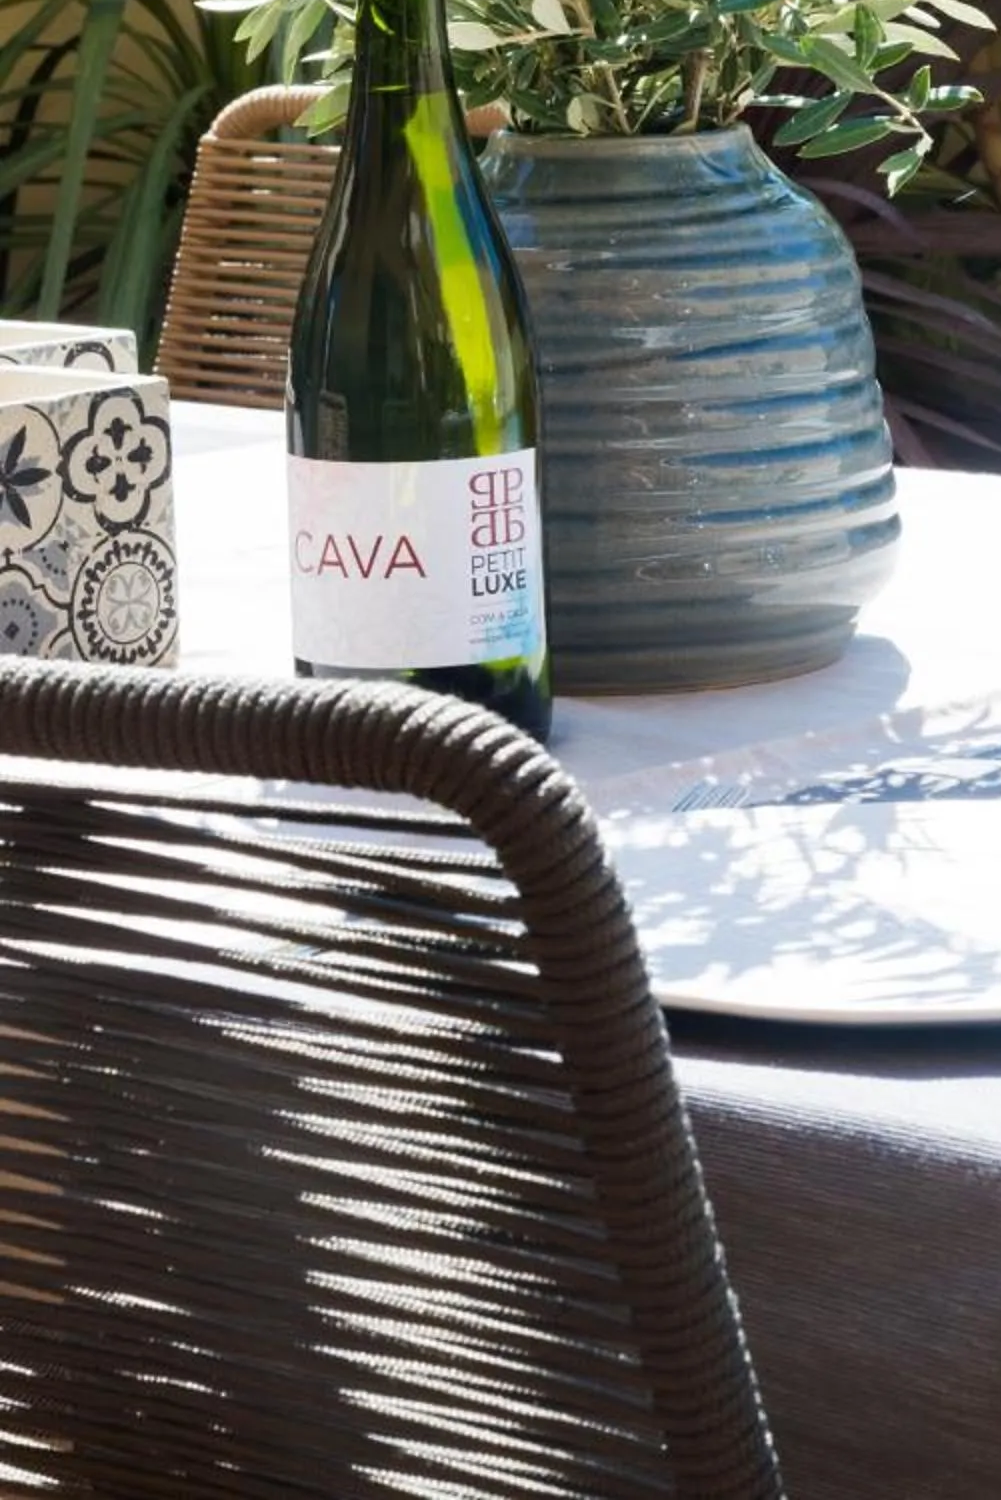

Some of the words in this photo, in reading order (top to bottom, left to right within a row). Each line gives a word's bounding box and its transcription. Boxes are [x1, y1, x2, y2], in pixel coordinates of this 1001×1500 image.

[295, 530, 427, 579] CAVA
[471, 547, 526, 575] PETIT
[471, 569, 527, 597] LUXE
